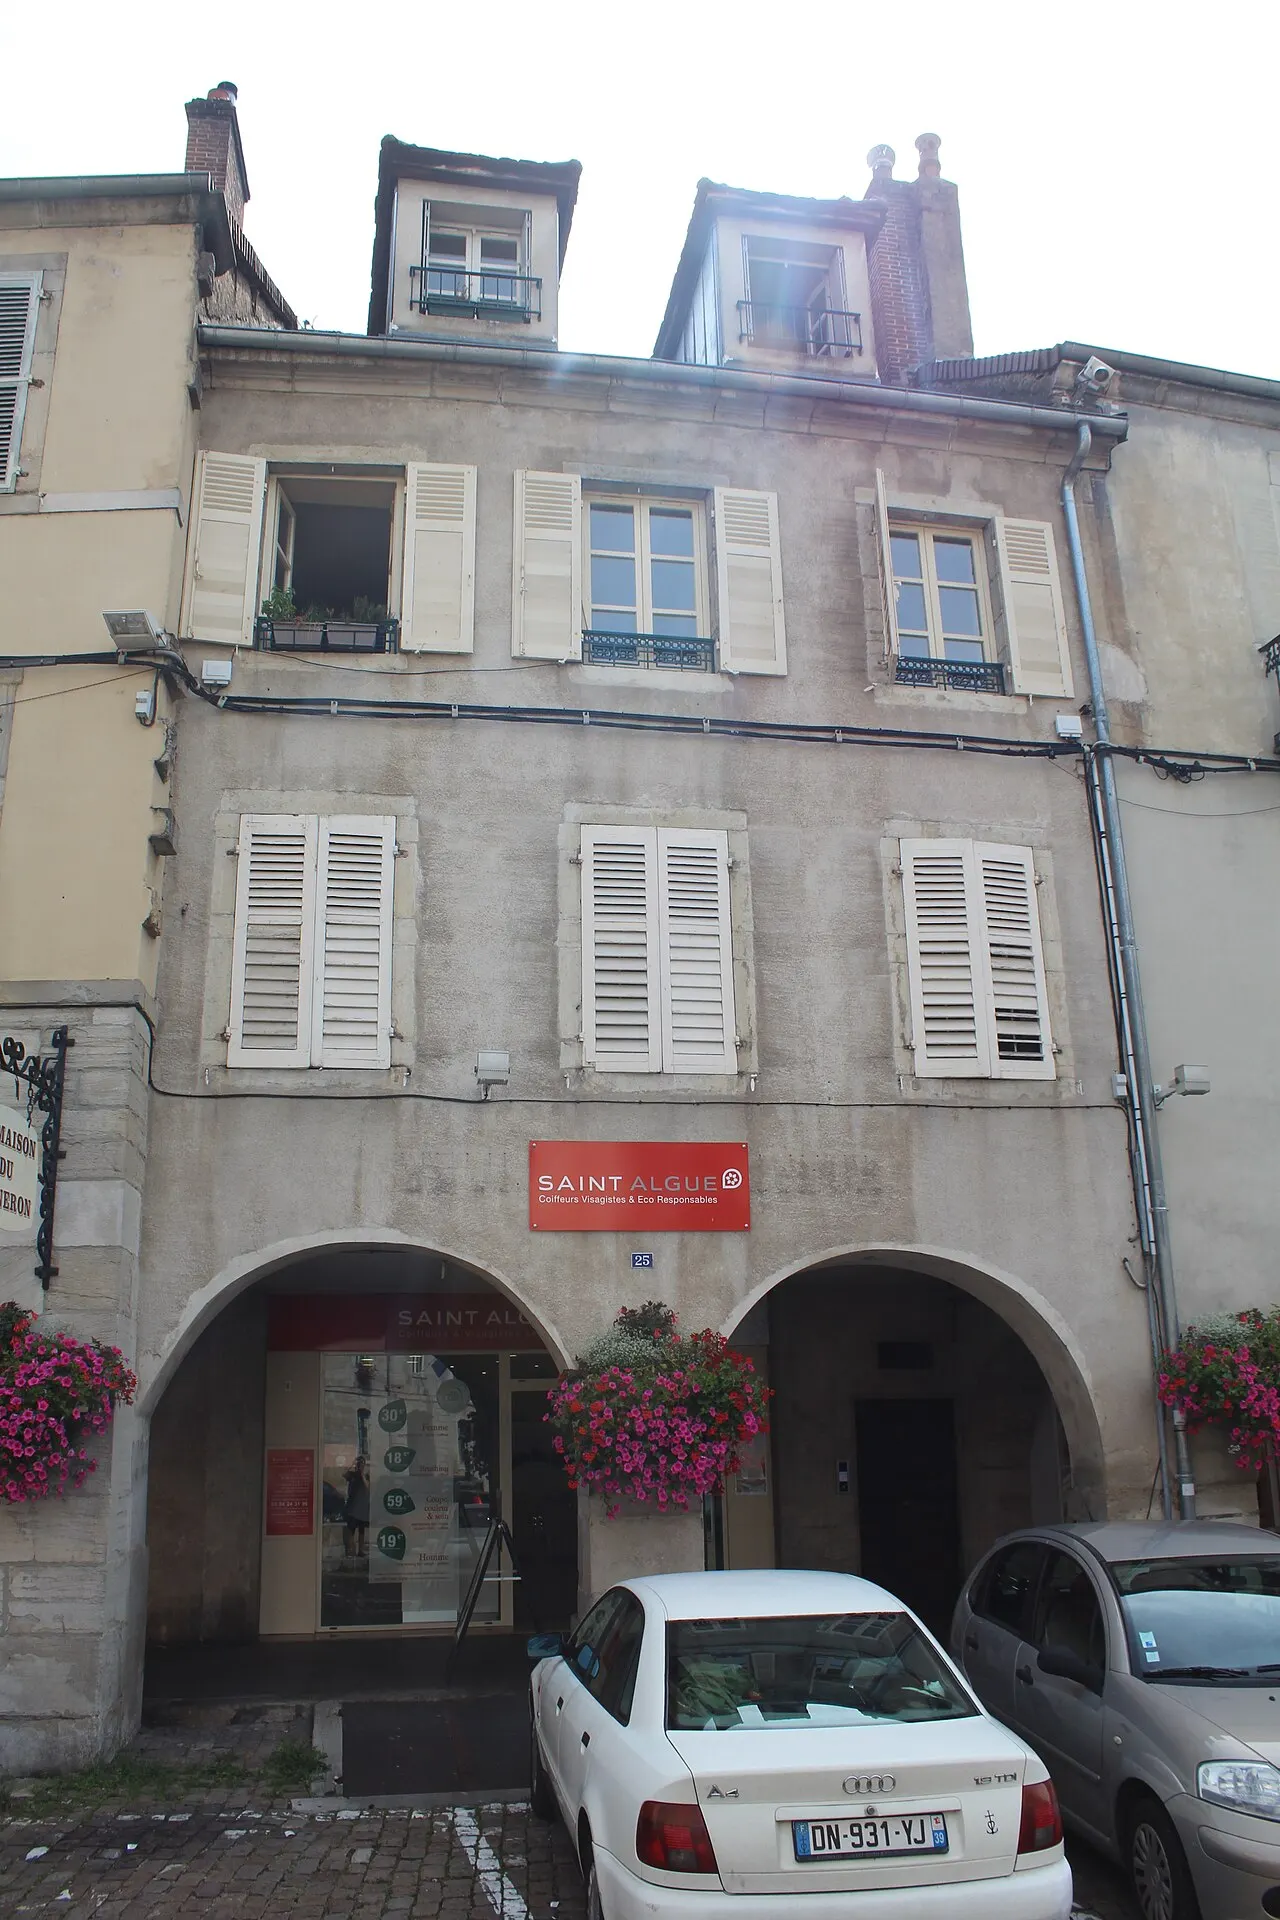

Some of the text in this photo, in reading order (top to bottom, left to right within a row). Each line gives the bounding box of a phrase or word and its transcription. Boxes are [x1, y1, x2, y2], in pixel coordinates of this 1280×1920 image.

[0, 1157, 14, 1178] DU
[538, 1175, 717, 1192] SAINT ALGUE
[538, 1194, 718, 1206] Coiffeurs Visagistes & Eco Responsables
[634, 1255, 650, 1266] 25
[398, 1310, 479, 1326] SAINT
[706, 1784, 740, 1799] A4
[811, 1818, 926, 1851] DN-931-YJ
[934, 1831, 945, 1844] 39
